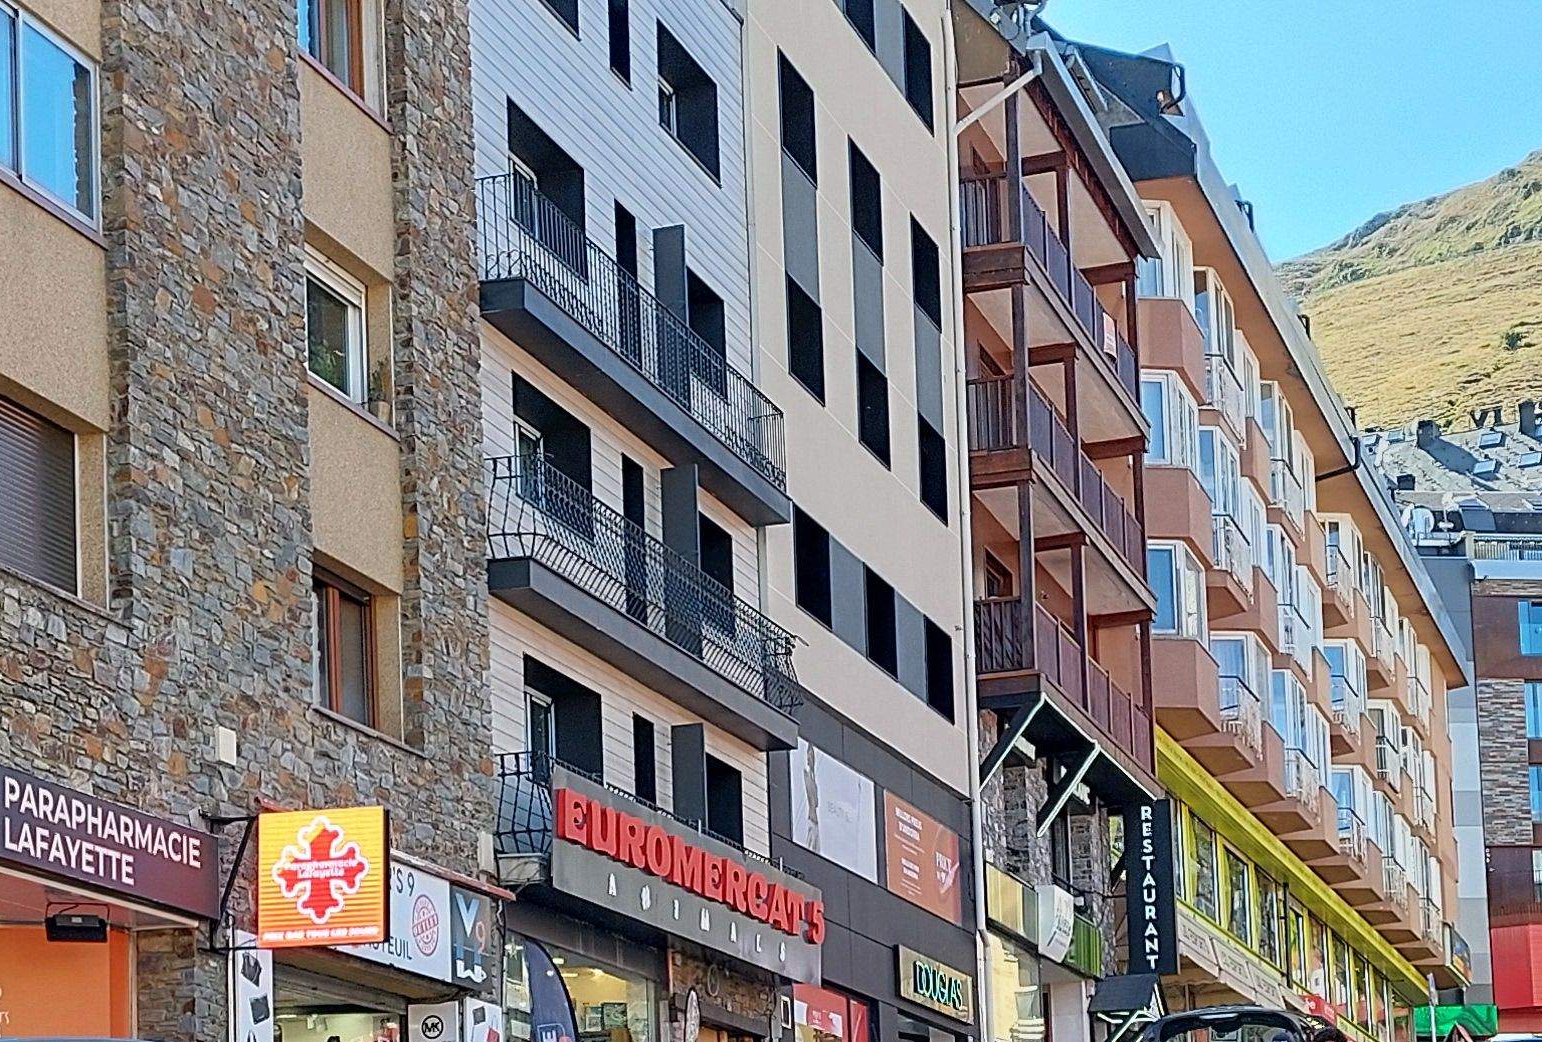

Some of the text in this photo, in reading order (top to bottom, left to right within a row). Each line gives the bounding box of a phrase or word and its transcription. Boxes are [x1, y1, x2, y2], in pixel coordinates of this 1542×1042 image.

[4, 775, 201, 869] PARAPHARMACIE
[4, 817, 135, 886] LAFAYETTE
[555, 788, 805, 936] EUROMERCAT
[1139, 805, 1161, 973] RESTAURANT
[913, 960, 963, 1010] DOUGLAS
